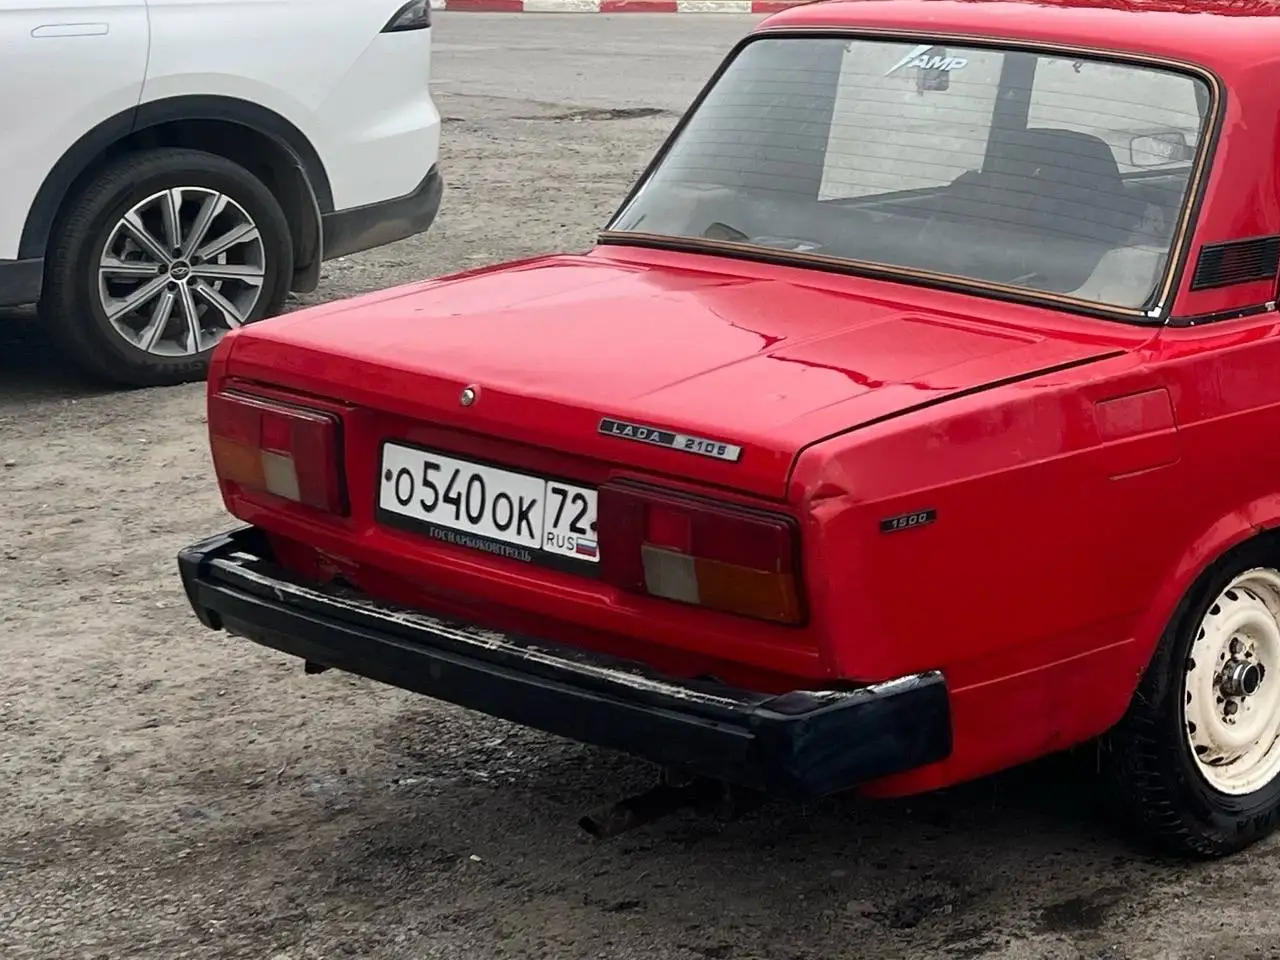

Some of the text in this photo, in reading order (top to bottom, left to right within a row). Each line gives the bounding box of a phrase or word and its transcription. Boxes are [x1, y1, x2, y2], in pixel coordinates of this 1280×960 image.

[612, 423, 727, 456] LADA 2105
[551, 487, 587, 535] 72
[892, 513, 927, 528] 1500
[546, 531, 575, 550] RUS
